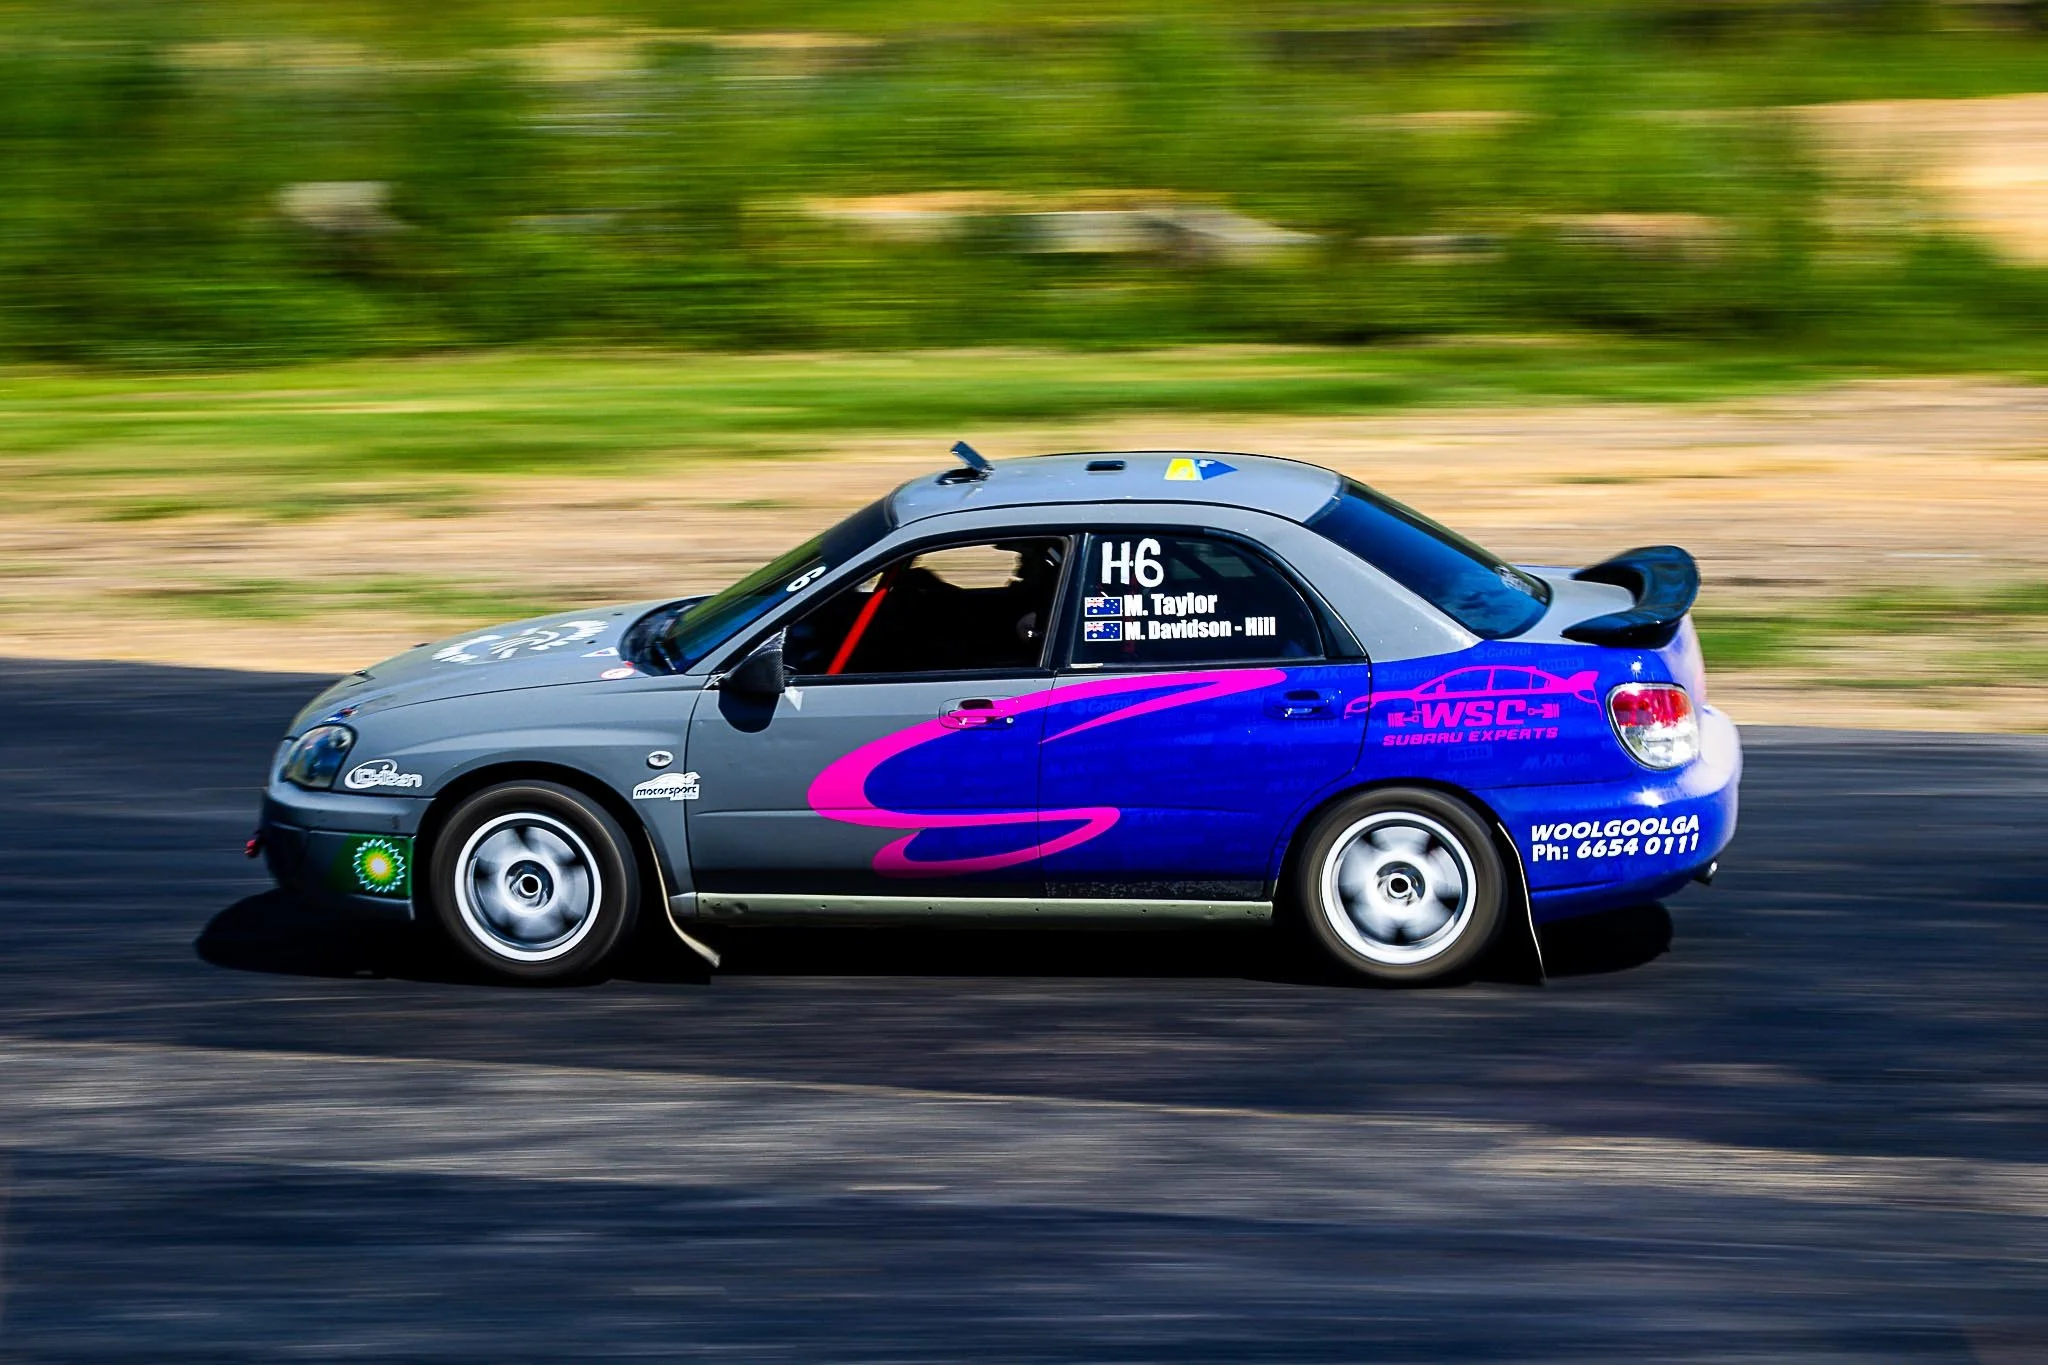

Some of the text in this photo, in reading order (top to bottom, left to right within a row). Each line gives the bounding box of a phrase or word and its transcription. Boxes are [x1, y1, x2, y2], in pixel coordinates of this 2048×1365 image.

[1101, 537, 1165, 588] H6
[1124, 591, 1218, 617] M. Taylor
[1124, 621, 1146, 641] M.
[1149, 618, 1232, 640] Davidson
[1421, 699, 1527, 729] WSC
[1382, 727, 1559, 747] SUBARU EXPERTS
[635, 786, 697, 798] motorsport
[1531, 814, 1700, 842] WOOLGOOLGA
[1532, 832, 1699, 862] Ph: 6654 0111
